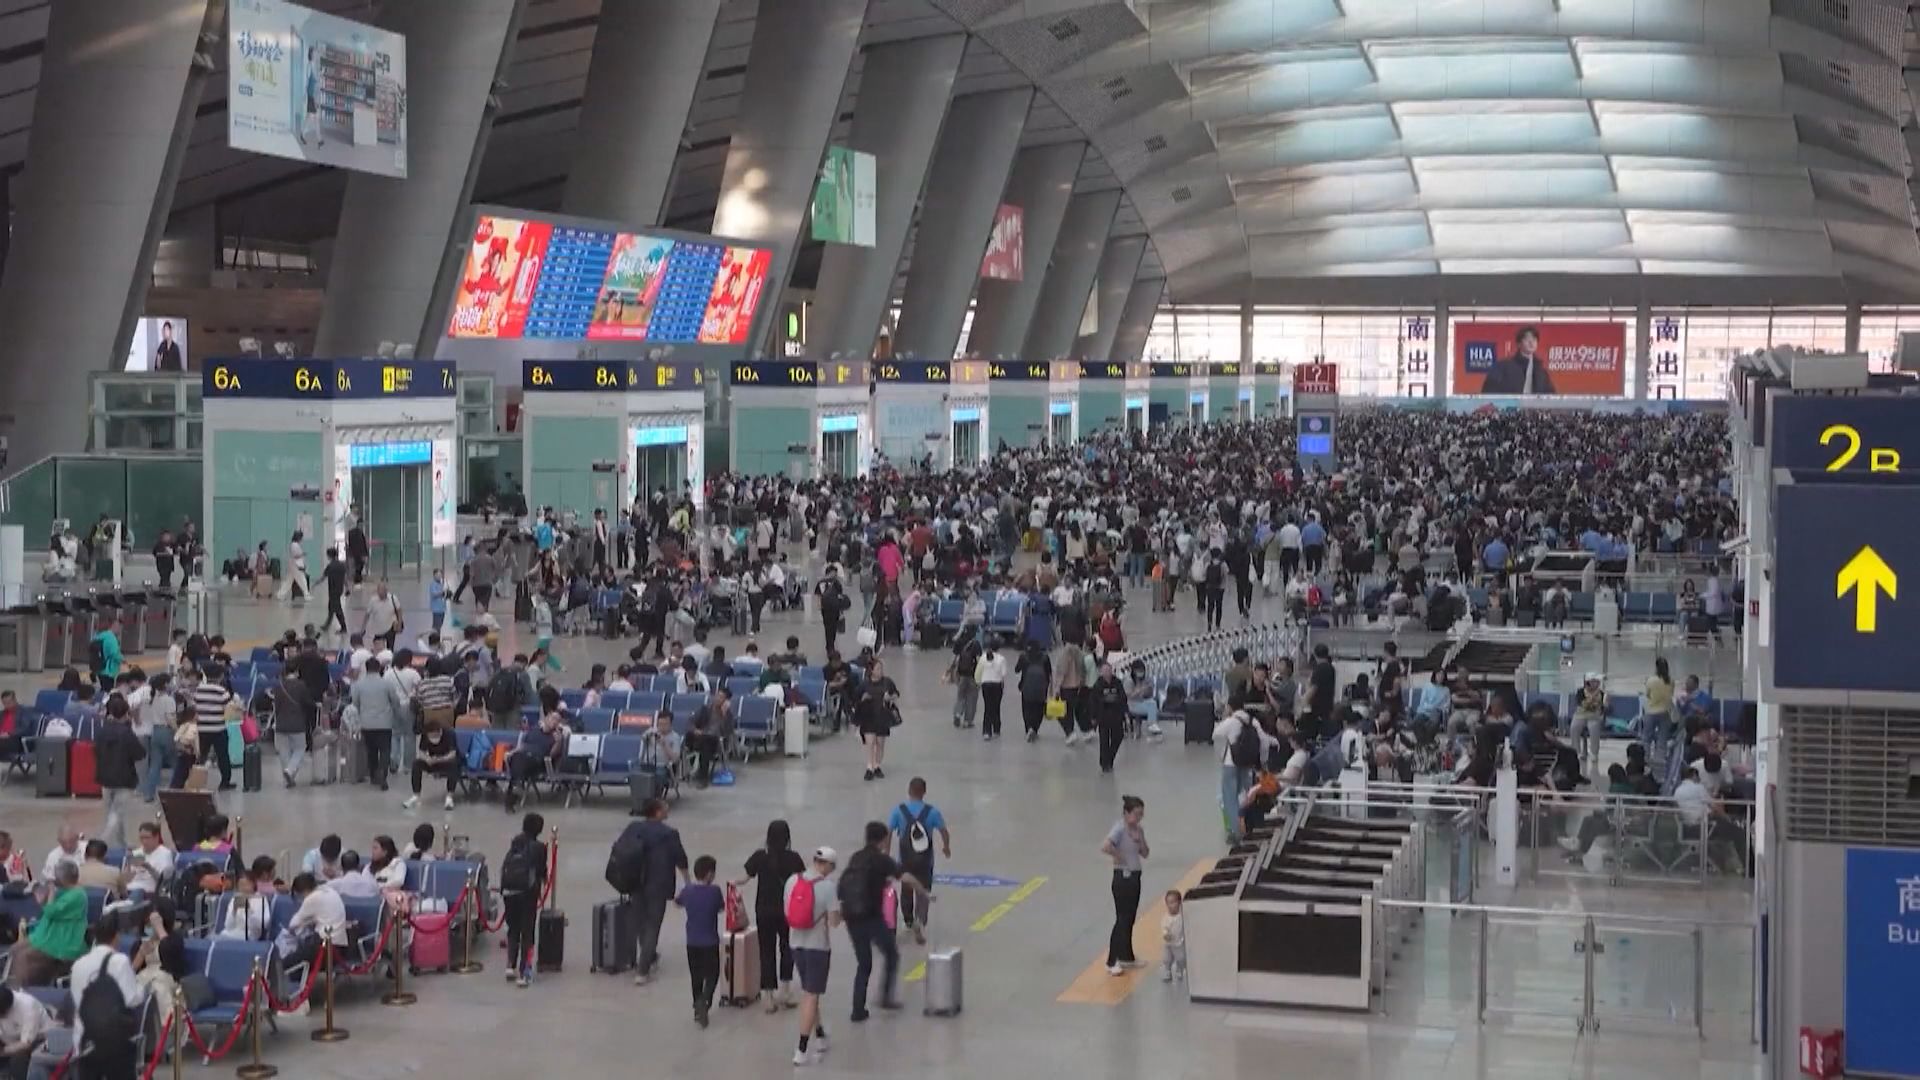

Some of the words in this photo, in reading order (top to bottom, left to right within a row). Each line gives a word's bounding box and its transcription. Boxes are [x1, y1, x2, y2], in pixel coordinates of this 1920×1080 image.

[1406, 317, 1430, 397] 南出口
[1469, 347, 1493, 361] HLA
[1655, 316, 1680, 400] 南出口
[214, 366, 241, 389] 6A
[295, 367, 323, 392] 6A
[338, 368, 351, 391] 6A
[441, 369, 453, 389] 7A
[532, 367, 553, 385] 8A
[596, 367, 617, 386] 8A
[628, 368, 638, 385] 8A
[736, 366, 759, 382] 10A
[788, 366, 813, 383] 10A
[880, 364, 901, 379] 12A
[926, 365, 946, 380] 12A
